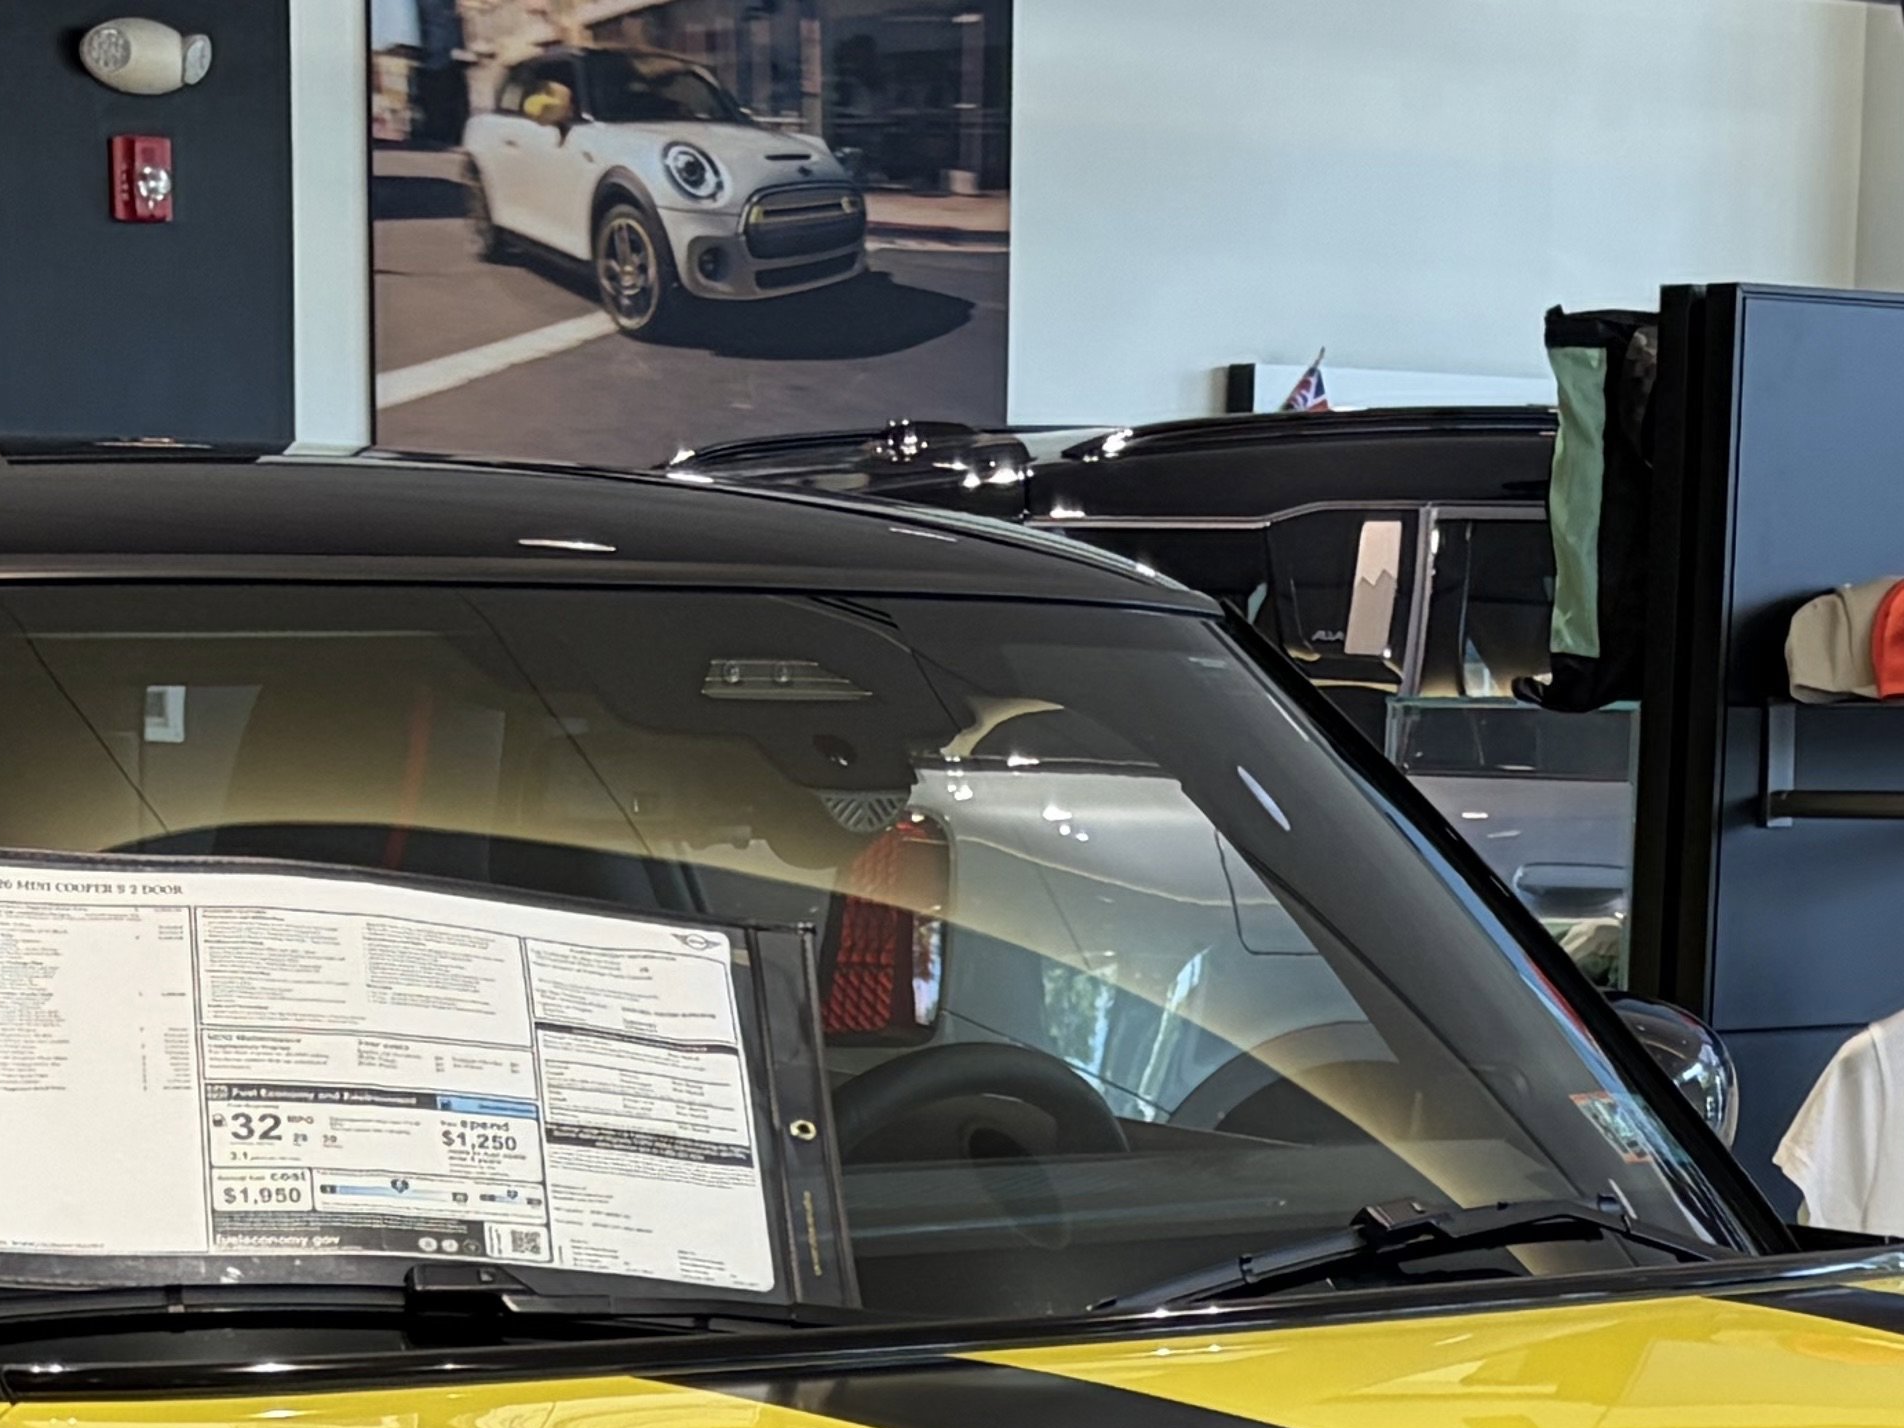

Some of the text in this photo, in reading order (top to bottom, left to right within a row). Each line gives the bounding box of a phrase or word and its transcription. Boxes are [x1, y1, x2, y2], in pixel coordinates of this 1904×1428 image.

[16, 881, 51, 892] MINI
[55, 882, 113, 894] COOPER
[130, 884, 138, 894] 2
[142, 884, 183, 895] DOOR
[232, 1088, 258, 1097] Fuel
[260, 1088, 315, 1100] Economy
[318, 1091, 340, 1099] and
[231, 1112, 283, 1141] 32
[460, 1120, 509, 1132] spend
[441, 1130, 518, 1151] $1,250
[230, 1151, 248, 1161] 3.1
[223, 1186, 302, 1204] $1,950
